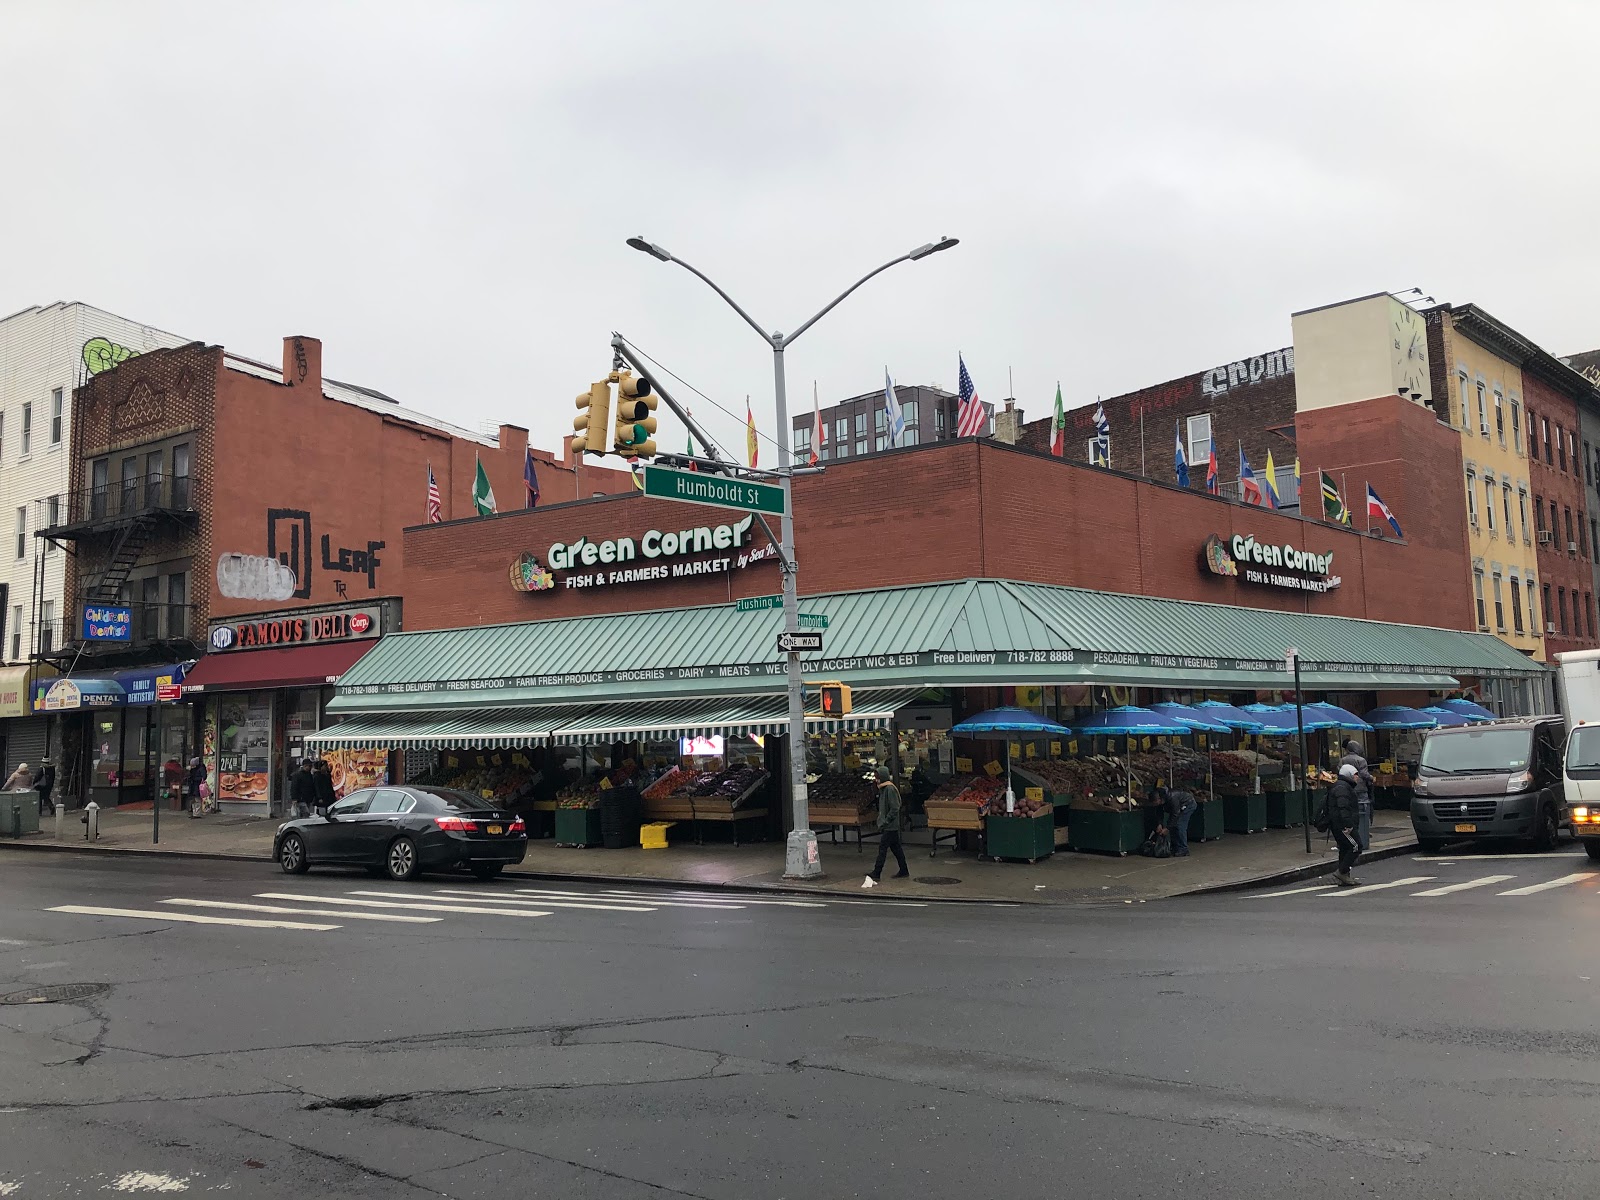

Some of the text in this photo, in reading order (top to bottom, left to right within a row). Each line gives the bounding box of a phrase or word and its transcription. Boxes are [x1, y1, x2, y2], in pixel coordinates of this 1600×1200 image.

[677, 477, 760, 505] Humboldt St
[547, 512, 754, 570] Green Corner
[737, 554, 749, 568] by
[749, 549, 765, 562] Sea
[1232, 534, 1334, 575] Green Corner
[566, 558, 730, 589] FISH & FARMERS MARKET
[1246, 570, 1262, 583] FISH
[1264, 574, 1269, 584] &
[1270, 574, 1301, 588] FARMERS
[736, 598, 773, 611] Flushing
[86, 608, 130, 623] Children's
[351, 616, 369, 629] Corp.
[90, 624, 127, 637] Dentist
[212, 627, 232, 648] SUPER
[237, 614, 346, 646] FAMOUS DELI
[783, 638, 817, 646] ONE WAY
[933, 652, 955, 663] Free
[957, 651, 996, 664] Delivery
[1049, 650, 1074, 662] 8888
[1093, 652, 1140, 665] PESCADERIA
[1151, 656, 1176, 666] FRUTAS
[1178, 657, 1184, 666] Y
[1183, 657, 1218, 669] VEGETALES
[1235, 660, 1268, 671] CARNICERIA
[1300, 662, 1318, 671] GRATIS
[1324, 663, 1353, 672] ACCEPTAMOS
[325, 675, 336, 683] OPEN
[341, 654, 920, 694] 718-782-1888 FREE DELIVERY FRESH SEAFOOD FARM FRESH PRODUCE GROCERIES DAIRY MEATS WE GDLY ACCEPT WIC & EBT
[132, 680, 151, 691] FAMILY
[127, 691, 155, 703] DENTISTRY
